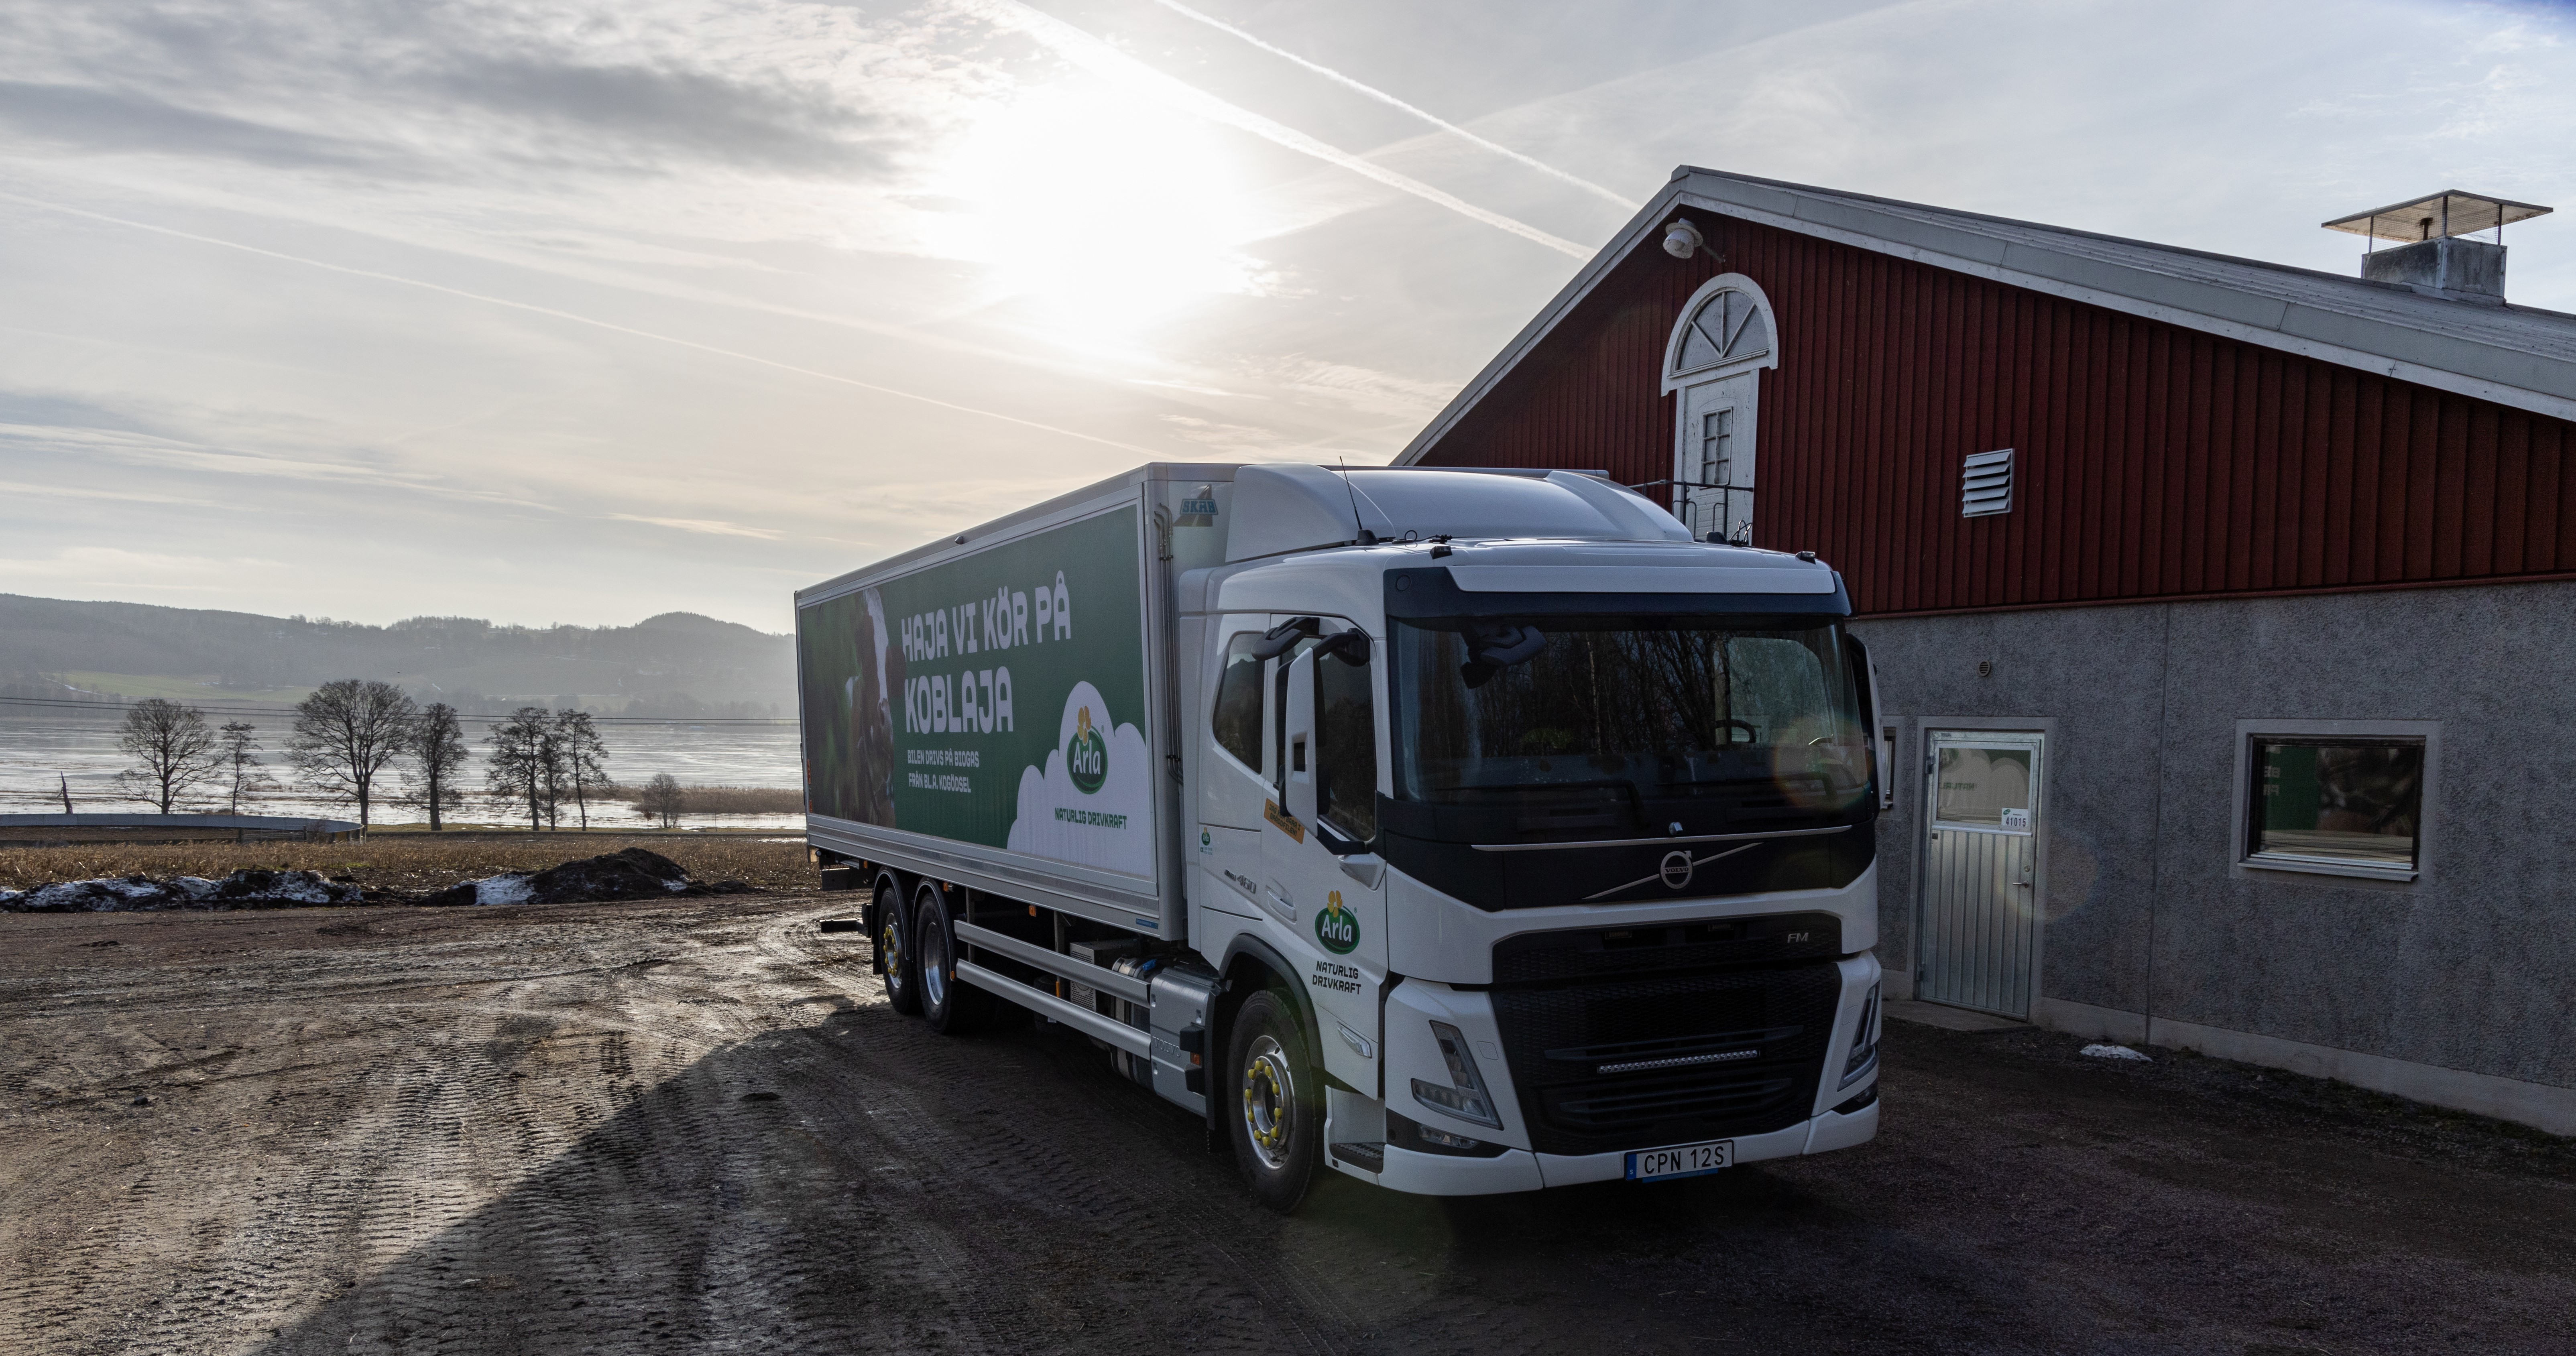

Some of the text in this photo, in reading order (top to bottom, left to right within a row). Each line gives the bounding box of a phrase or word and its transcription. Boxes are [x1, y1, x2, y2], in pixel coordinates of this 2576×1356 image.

[1182, 501, 1216, 513] SKAB
[901, 570, 1071, 662] HAJA VI KÖR PÅ
[904, 666, 1013, 734] KOBLAJA
[907, 748, 979, 768] BILEN DRIVS PÅ BIOGAS
[1073, 740, 1101, 775] Arla
[908, 771, 972, 793] FRÅN BL.A. KOGÖDSEL
[1055, 808, 1127, 829] NATURLIG DRIVKRAFT
[2006, 817, 2026, 827] 41015
[1237, 874, 1256, 894] 460
[1322, 915, 1351, 942] Arla
[1788, 933, 1808, 943] FM
[1316, 961, 1359, 979] NATURLIG
[1312, 974, 1361, 994] DRIVKRAFT
[1152, 1036, 1181, 1057] VOLVO
[1644, 1151, 1681, 1174] CPN
[1691, 1146, 1724, 1168] 12S
